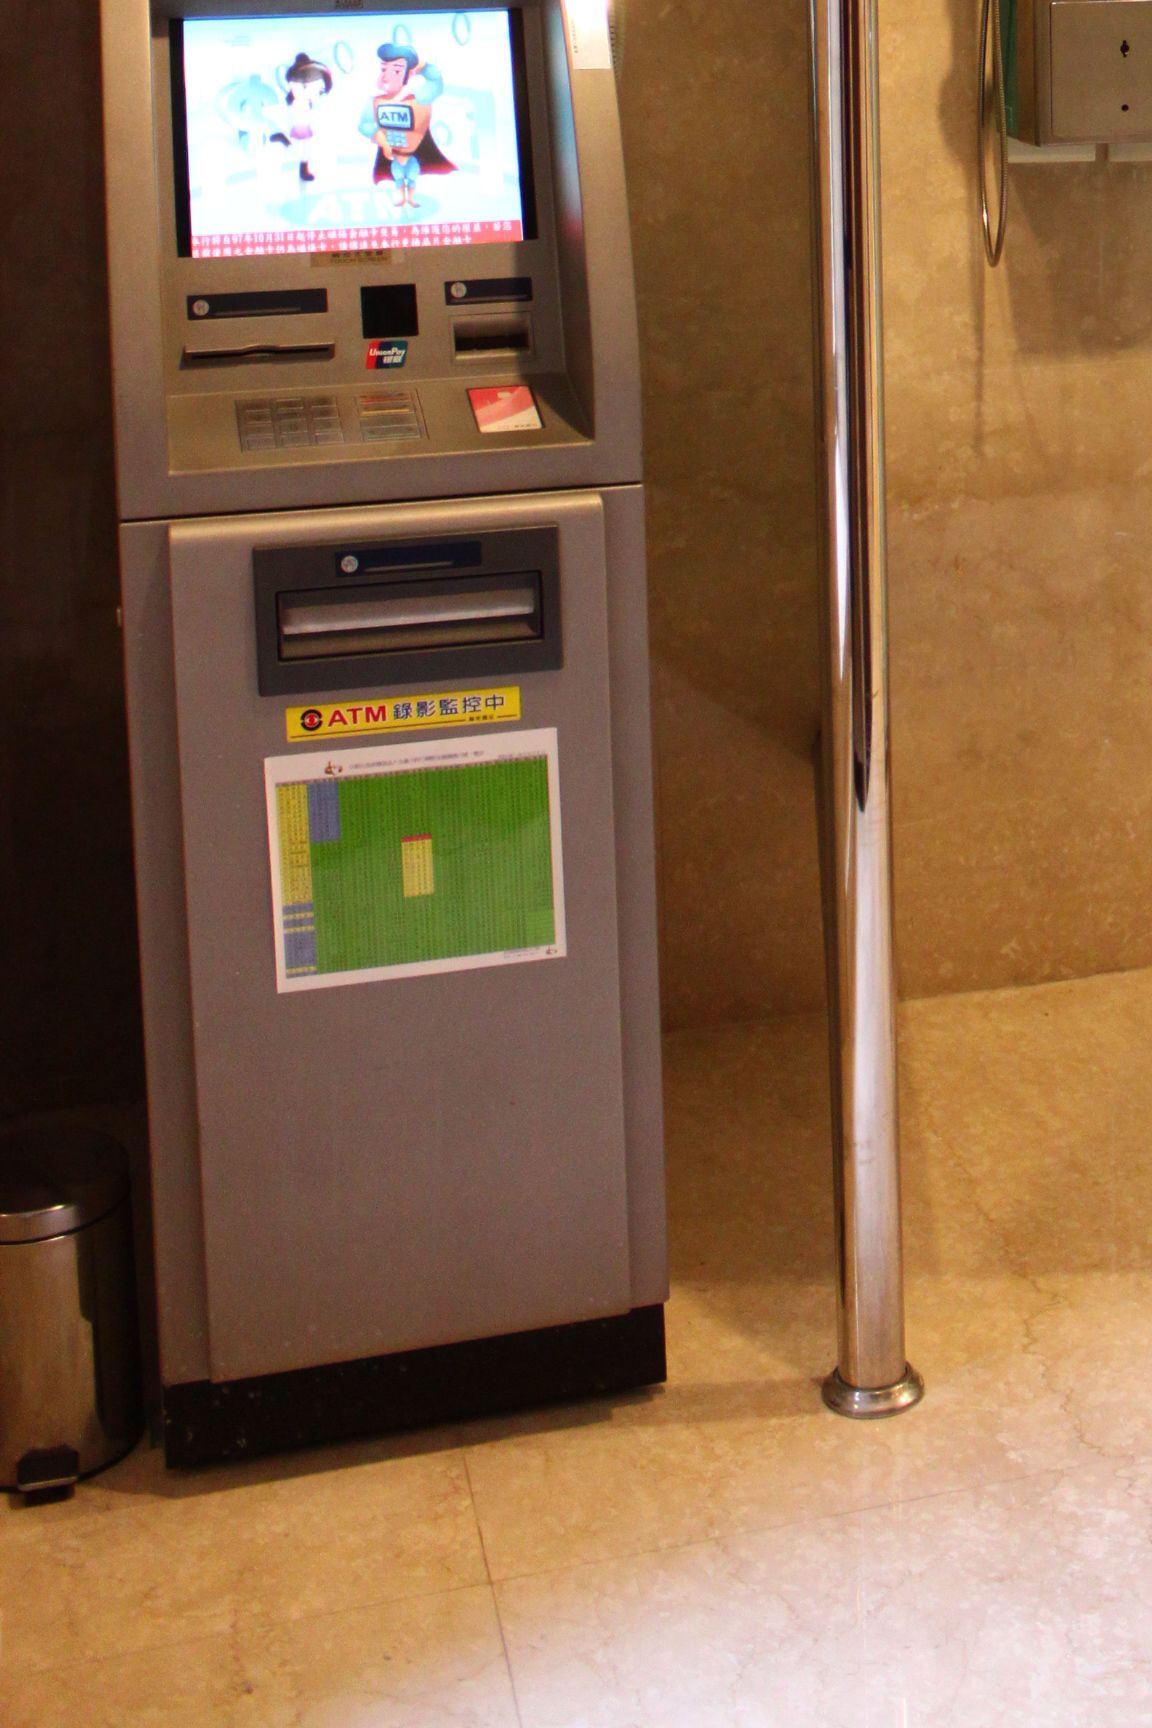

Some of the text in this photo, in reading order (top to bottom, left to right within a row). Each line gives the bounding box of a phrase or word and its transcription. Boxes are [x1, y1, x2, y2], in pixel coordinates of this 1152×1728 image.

[379, 110, 409, 124] ATM
[369, 347, 406, 357] UnionPay
[327, 694, 505, 727] ATM 錄影監控中
